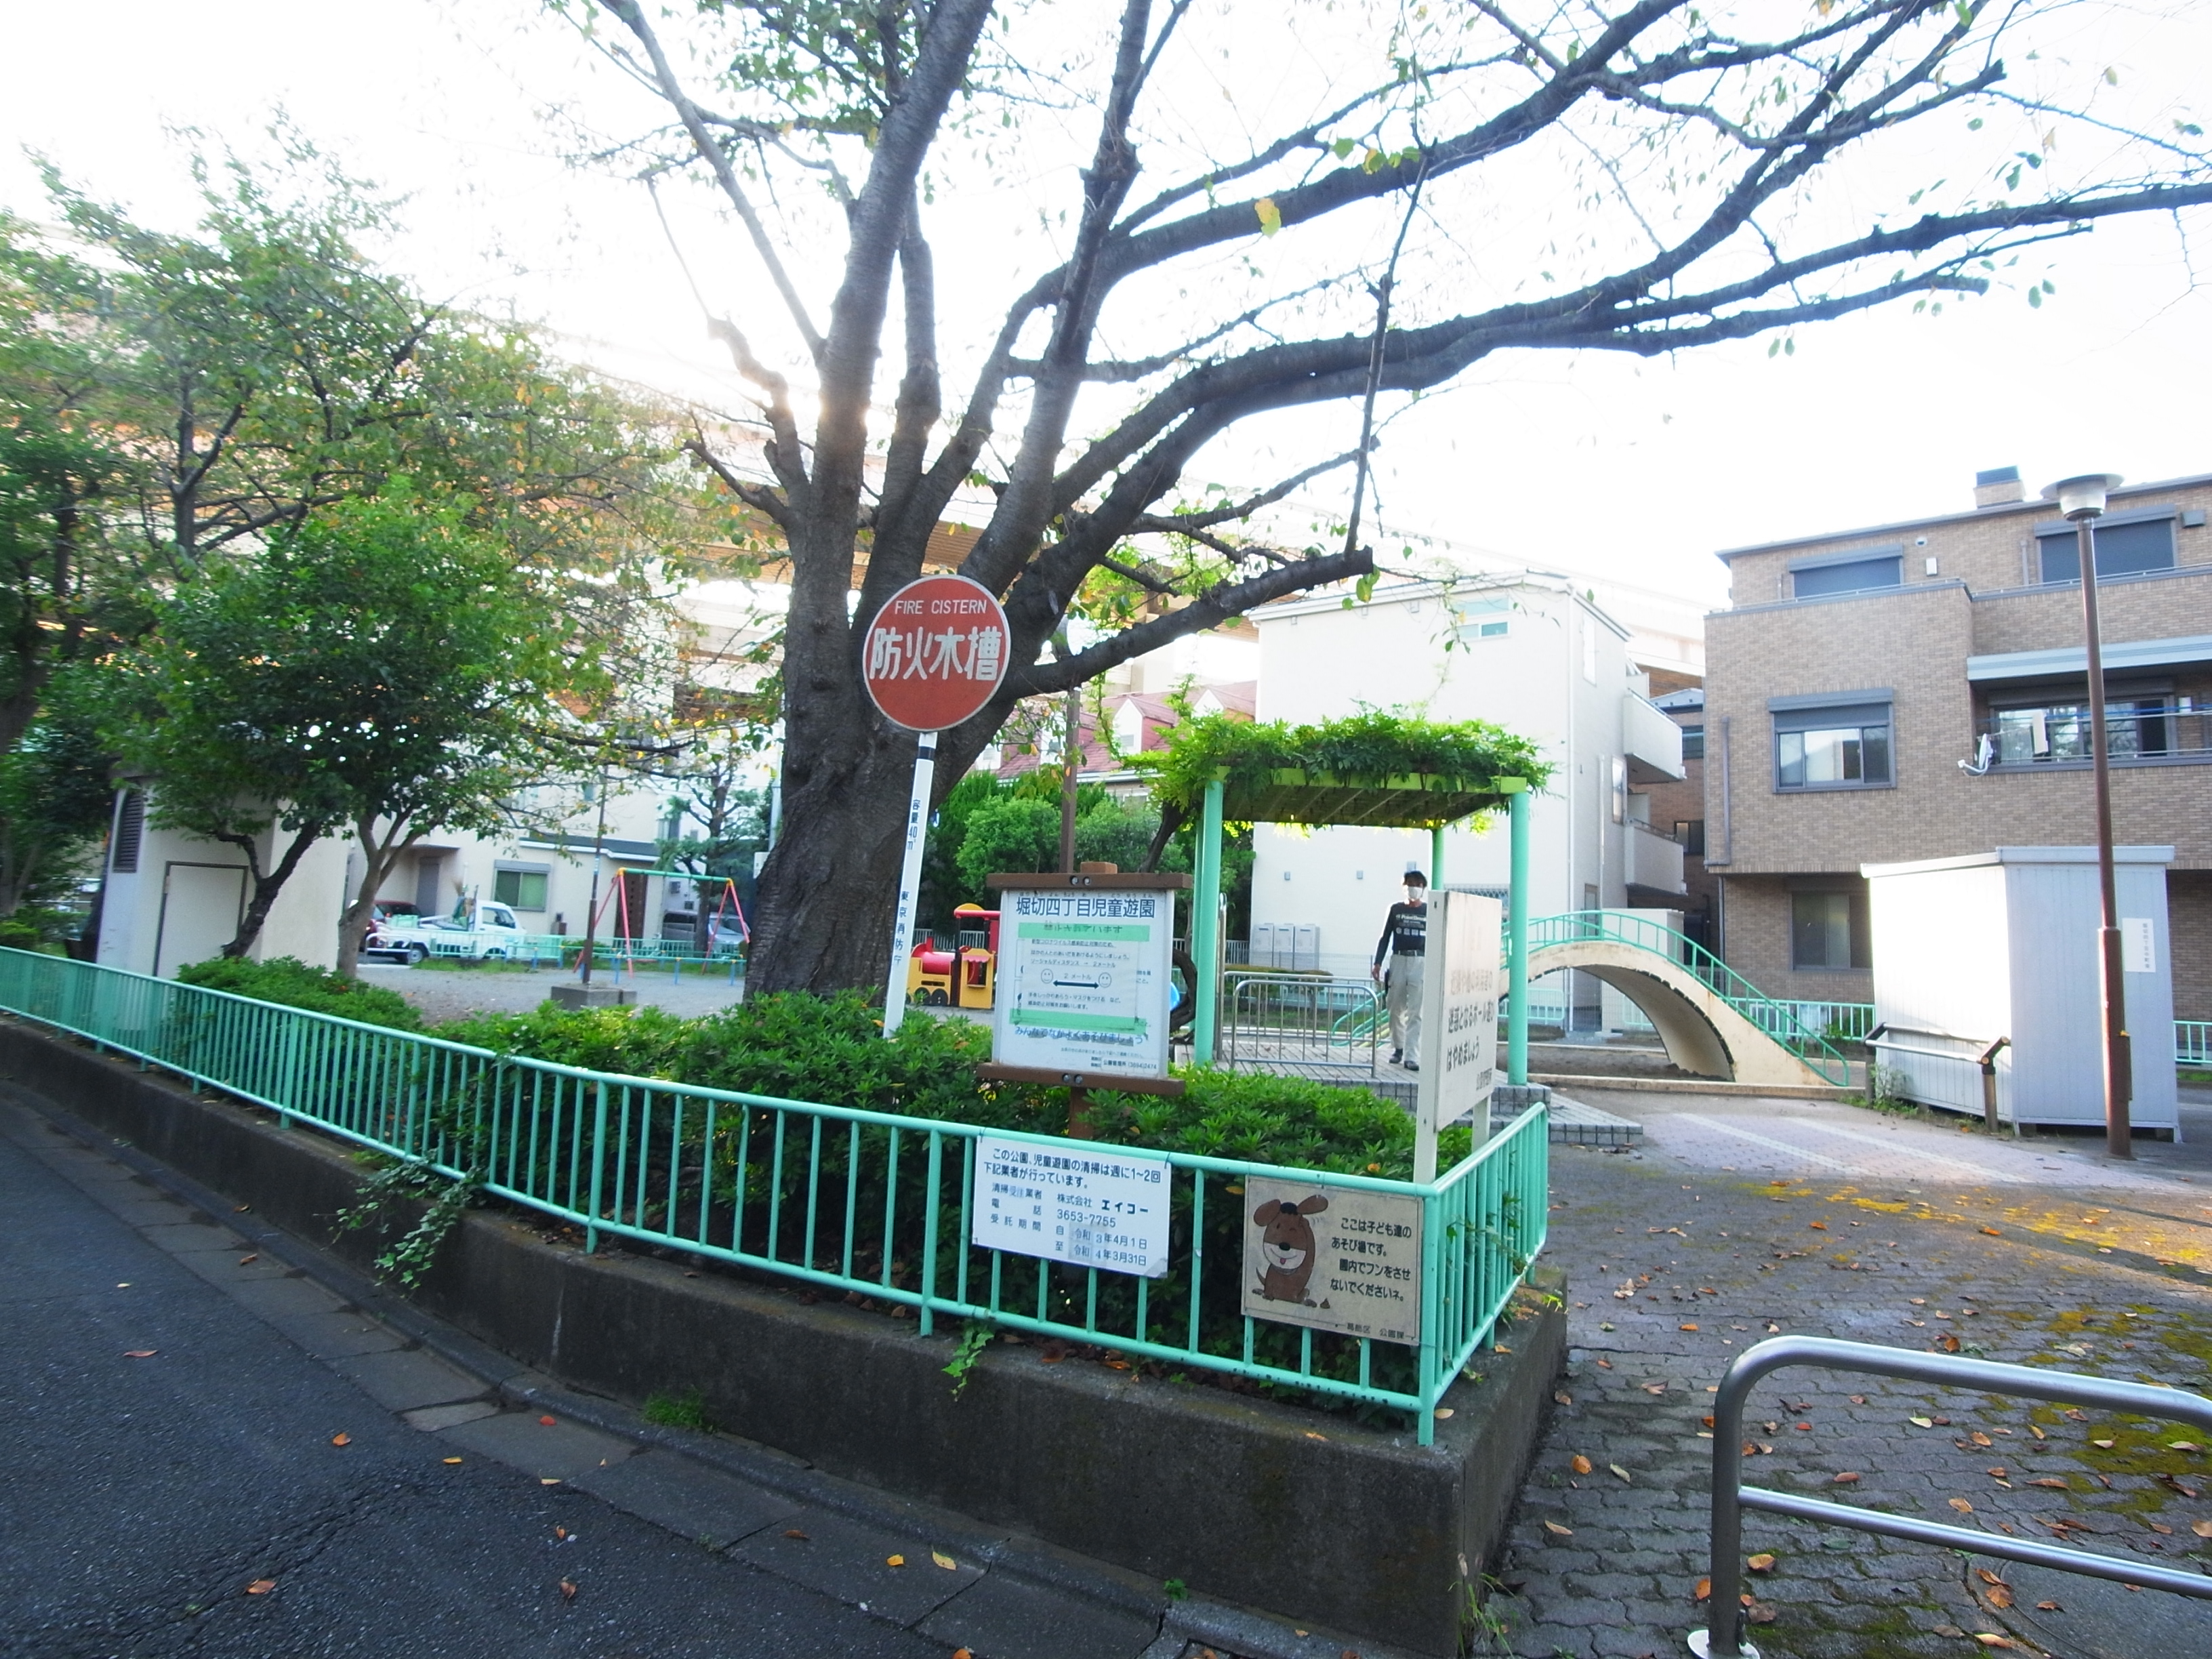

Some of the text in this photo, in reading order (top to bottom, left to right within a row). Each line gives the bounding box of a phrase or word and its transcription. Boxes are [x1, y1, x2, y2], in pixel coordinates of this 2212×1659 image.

[895, 600, 987, 615] FIRE CISTERN
[1016, 896, 1155, 918] 堀切四丁目児童遊園
[1446, 1036, 1480, 1073] はやめましょう
[984, 1162, 1088, 1189] 下記業者が行っています。
[1057, 1193, 1092, 1208] 株式会社
[1101, 1199, 1148, 1214] エイコー
[1057, 1208, 1116, 1228] 3653-7755
[1340, 1217, 1412, 1239] ここは子ども達の
[1332, 1237, 1387, 1257] あそび場です。
[1339, 1258, 1411, 1281] 園内でフンをさせ
[1330, 1278, 1404, 1302] ないでくださいネ。
